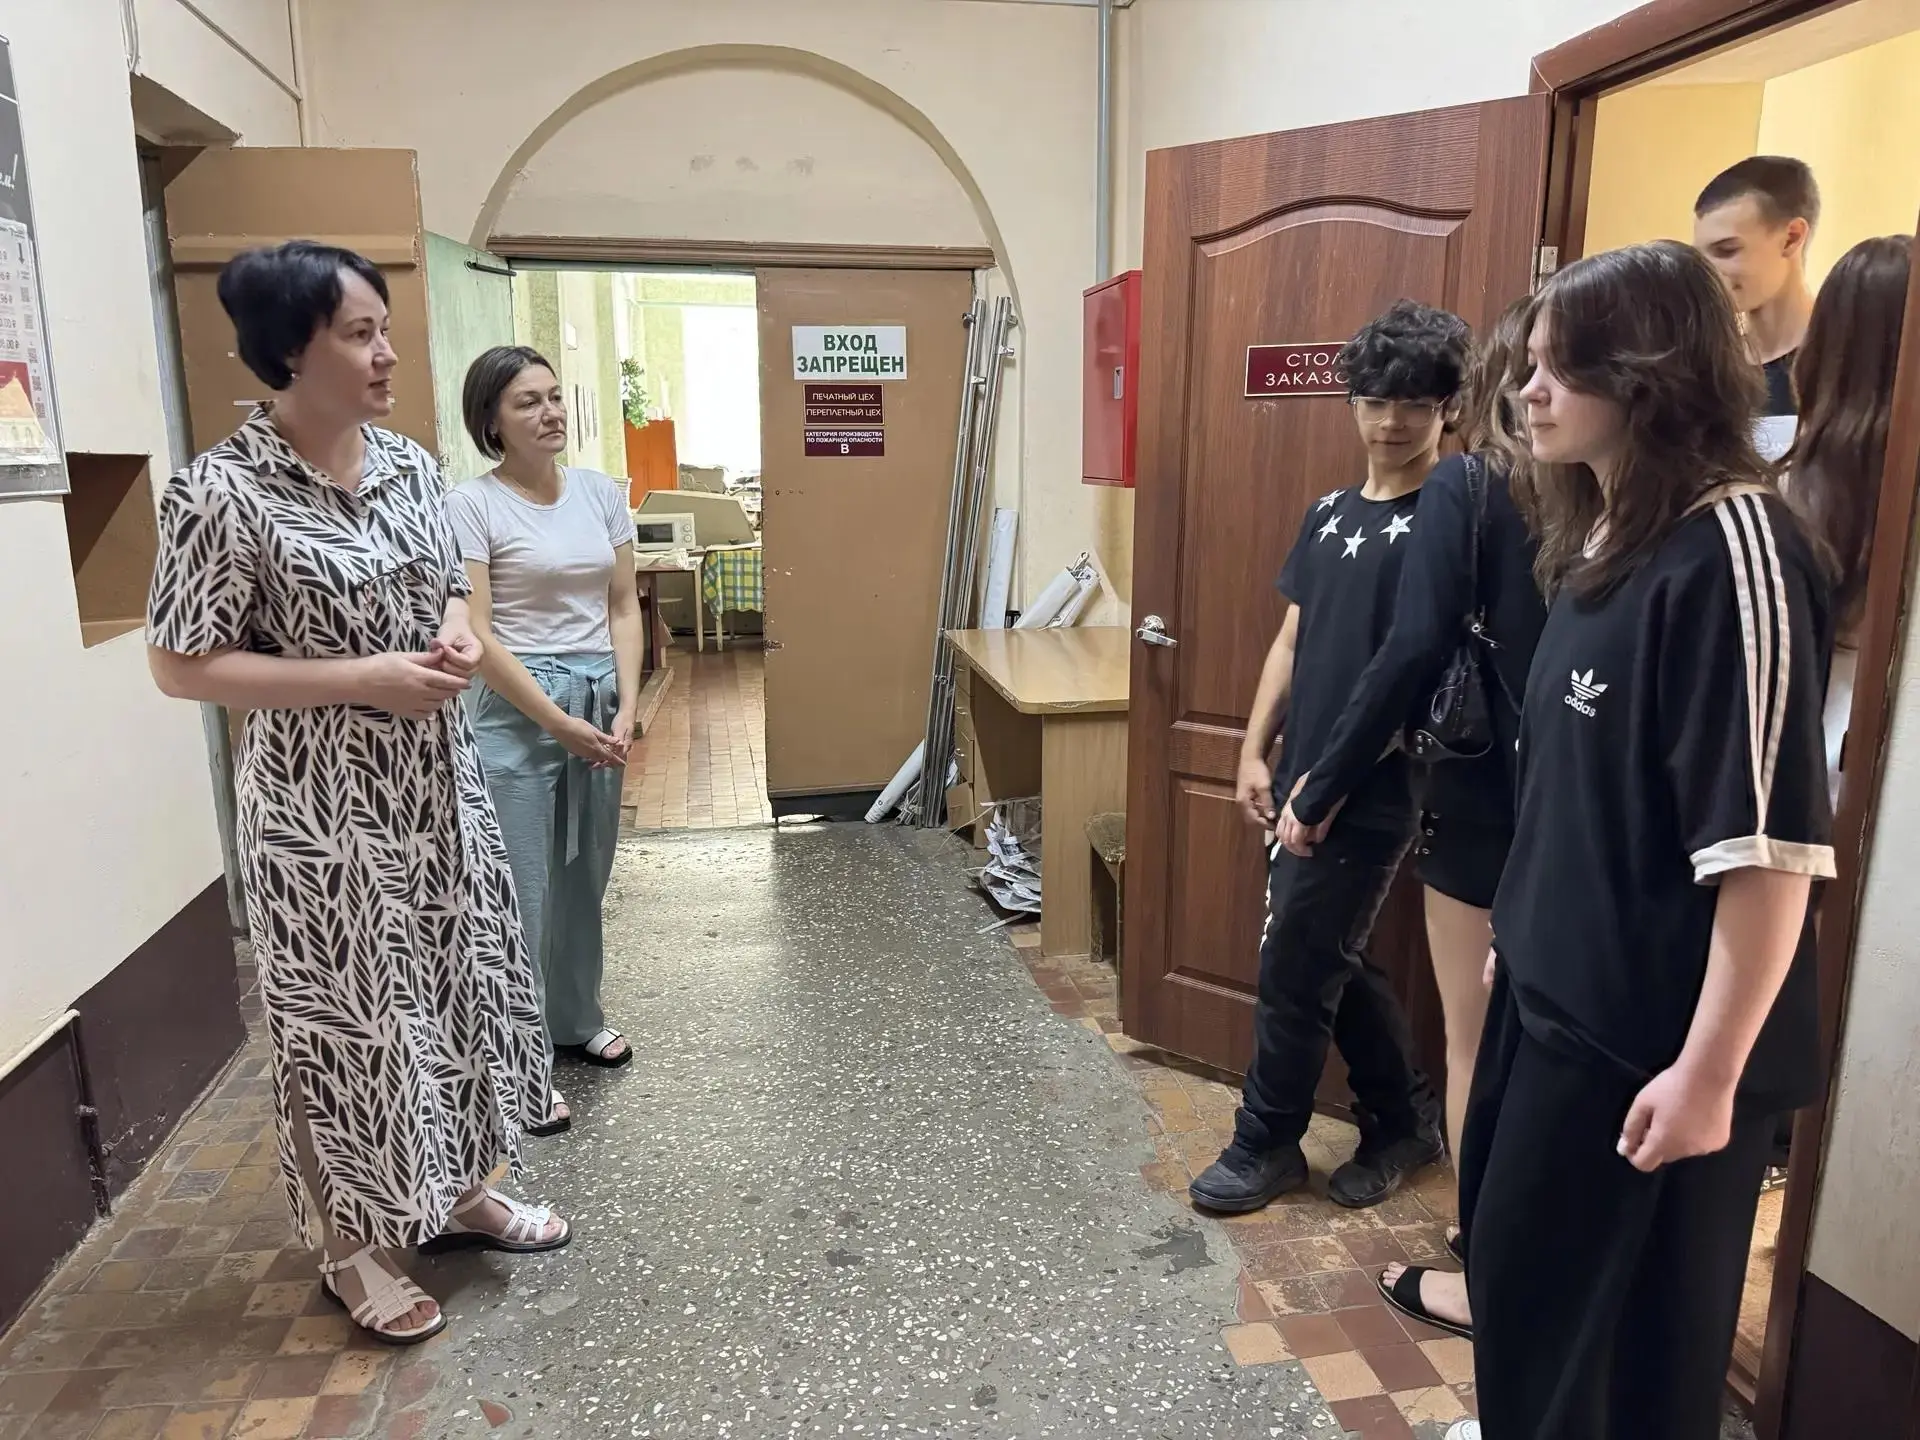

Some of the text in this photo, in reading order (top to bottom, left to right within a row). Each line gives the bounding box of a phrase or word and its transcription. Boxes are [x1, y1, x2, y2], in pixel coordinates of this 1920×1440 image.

[823, 334, 877, 354] ВХОД
[796, 355, 904, 376] ЗАПРЕЩЕН
[1265, 370, 1350, 386] ЗАКАЗО
[812, 392, 875, 402] ПЕЧАТНЫЙ ЦЕХ
[806, 408, 881, 417] ПЕРЕПЛЕТНЫЙ ЦЕХ
[1564, 695, 1596, 717] addas
